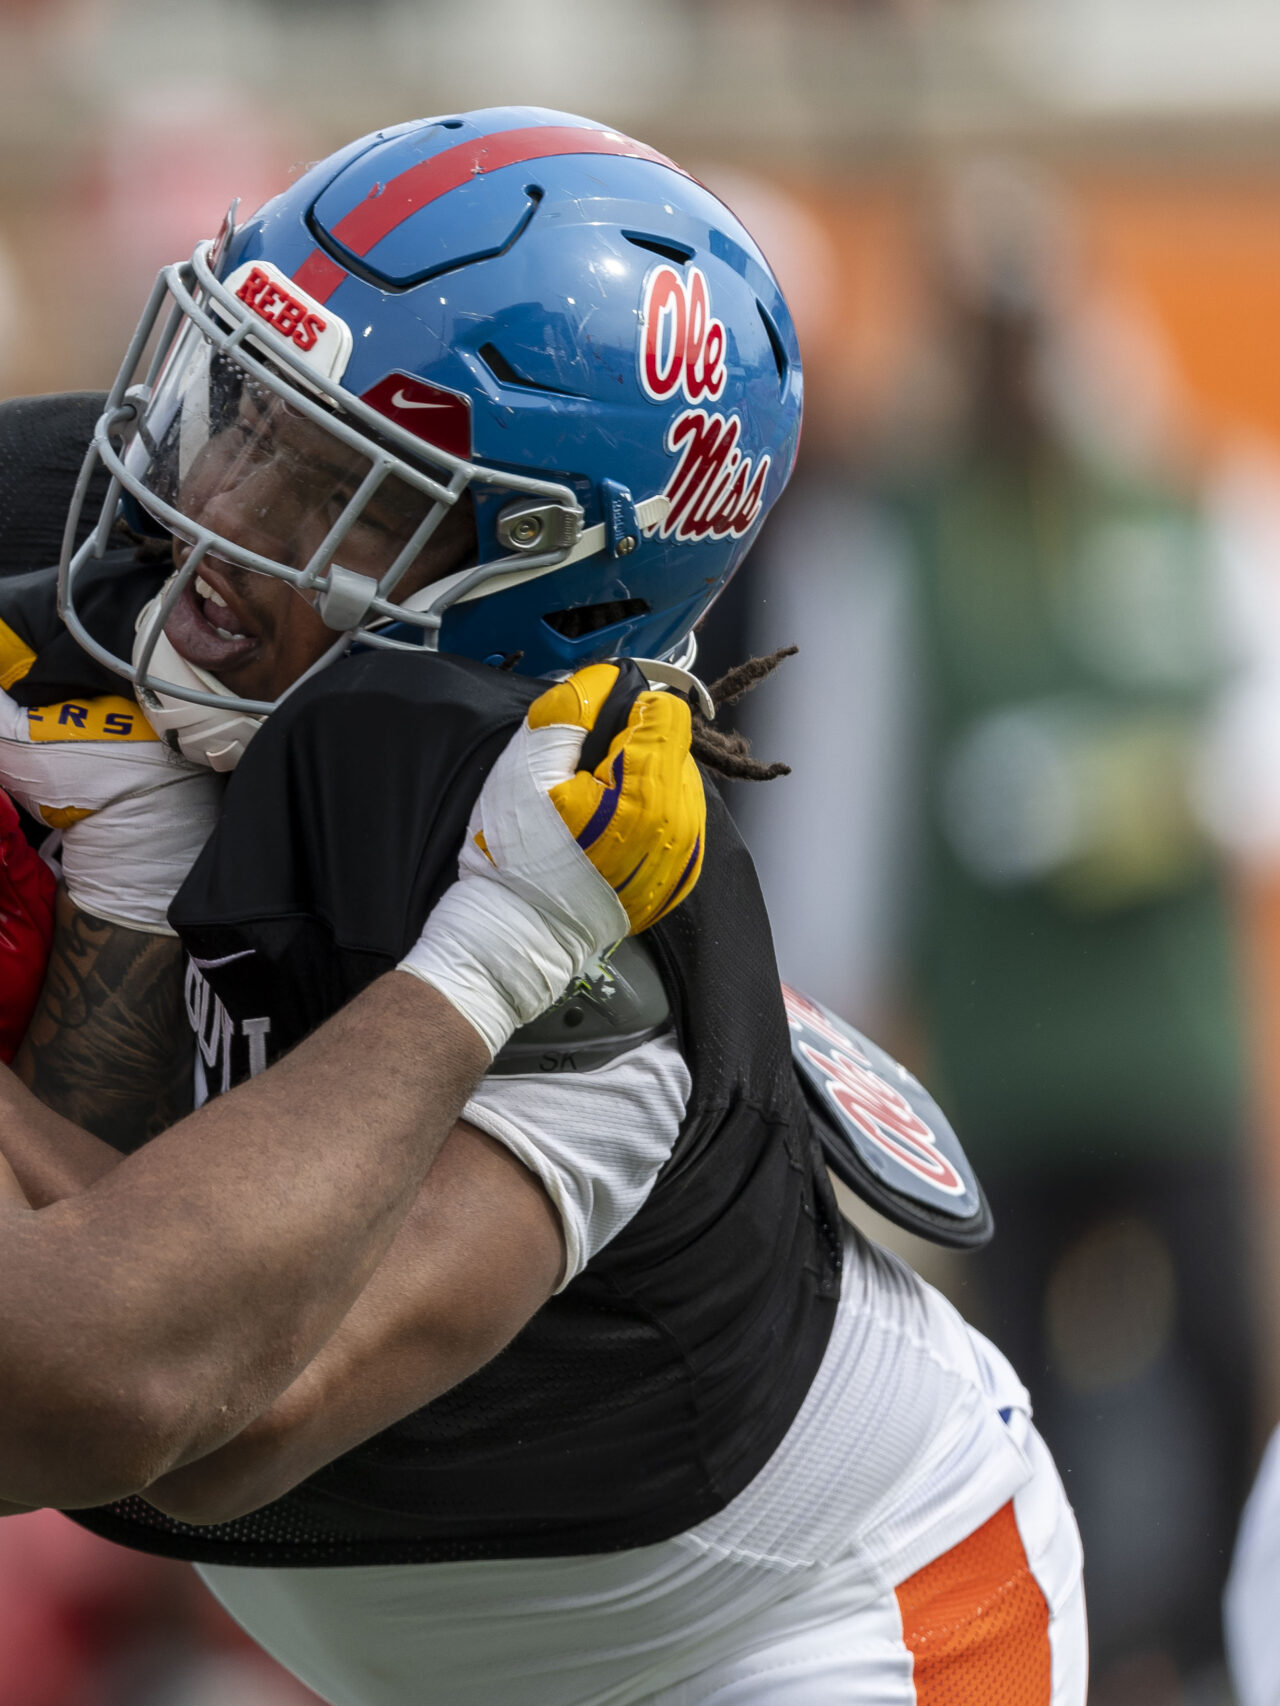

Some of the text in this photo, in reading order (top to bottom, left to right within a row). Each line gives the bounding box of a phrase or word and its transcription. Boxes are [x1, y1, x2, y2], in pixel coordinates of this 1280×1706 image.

[235, 266, 327, 352] REBS
[639, 264, 728, 405] Ole
[642, 408, 771, 542] Miss
